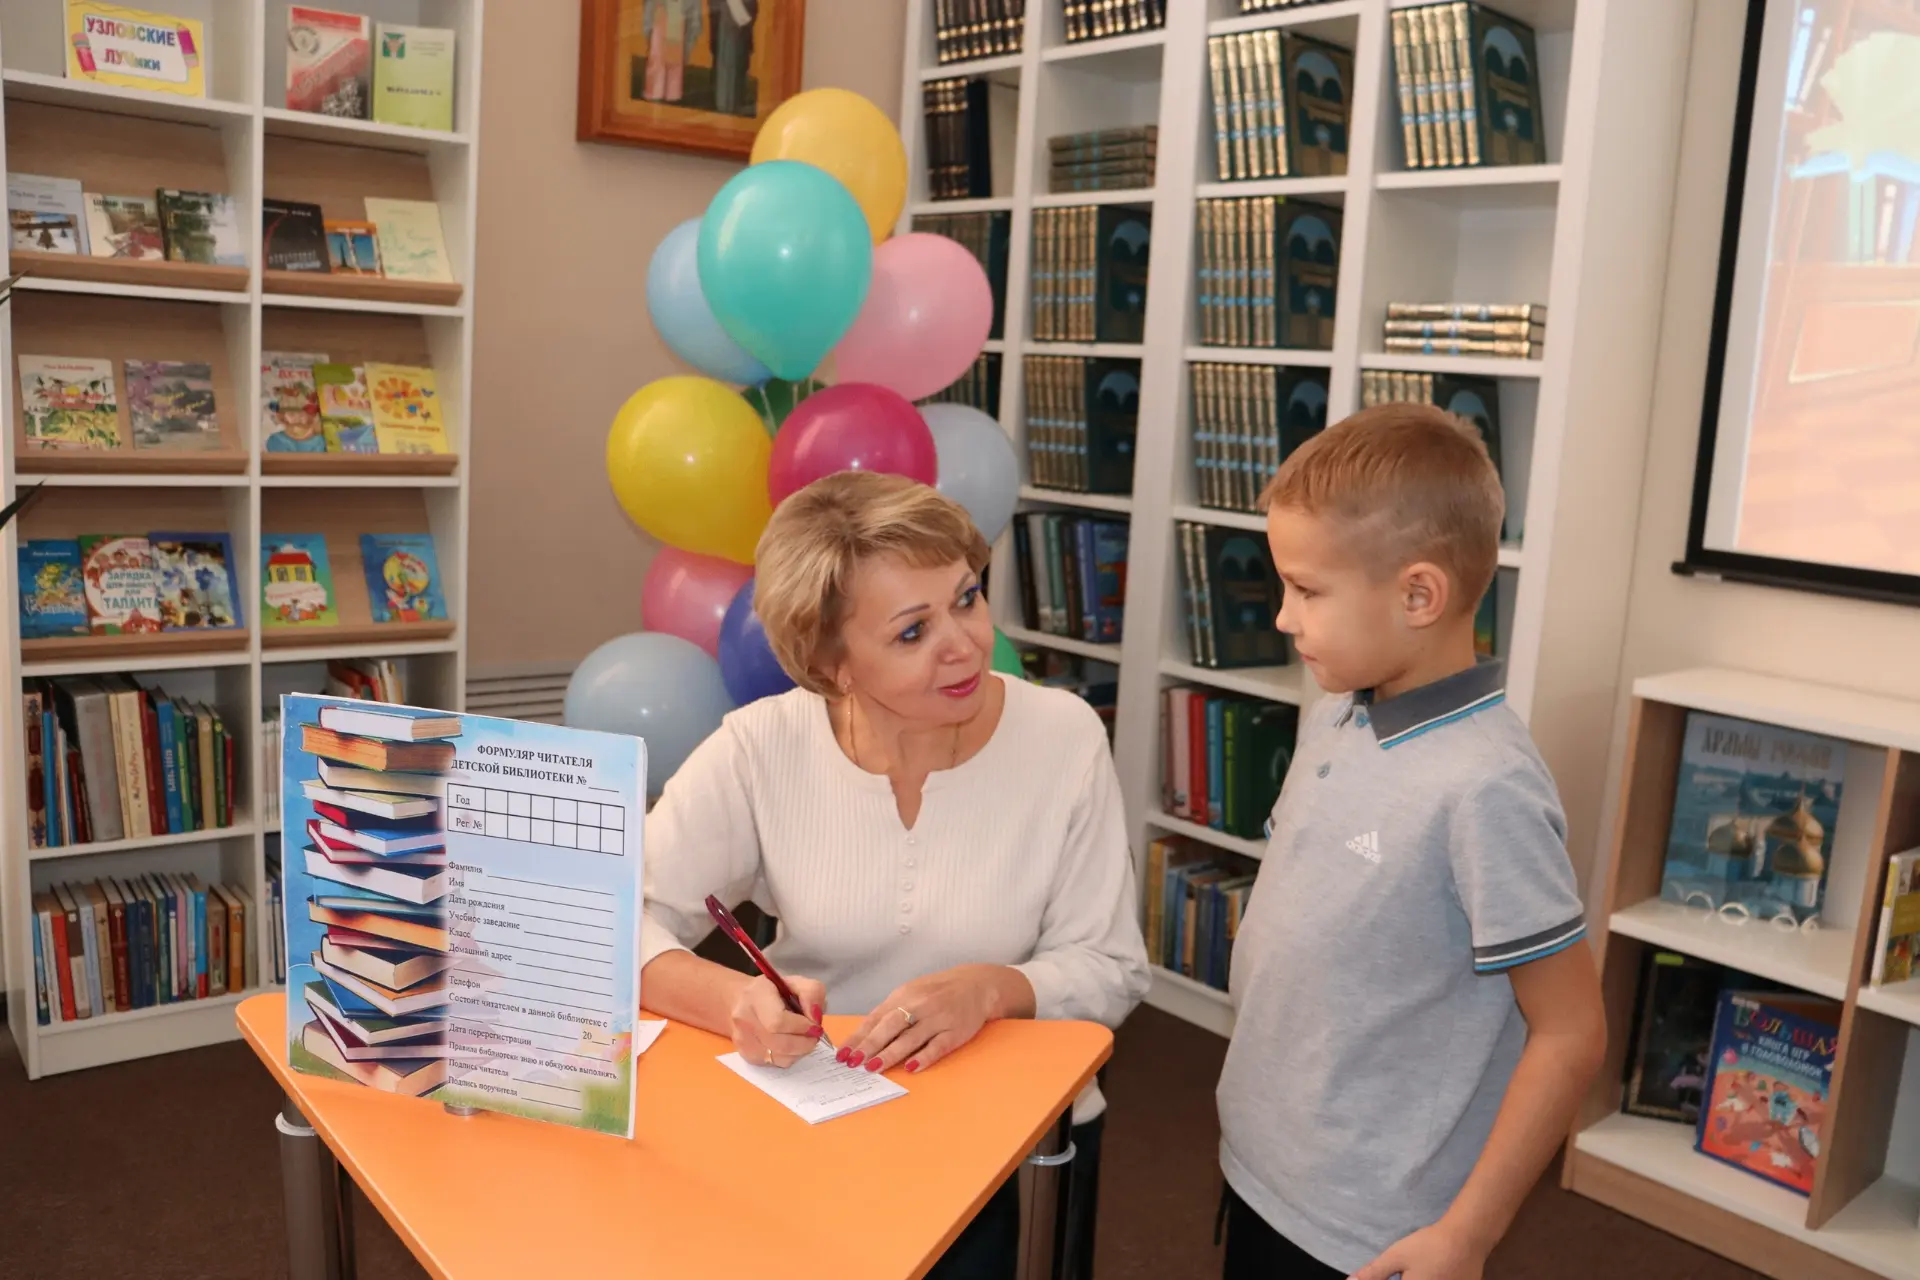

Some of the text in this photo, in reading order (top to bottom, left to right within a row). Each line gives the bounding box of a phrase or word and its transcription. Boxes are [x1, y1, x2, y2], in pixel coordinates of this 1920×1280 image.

[86, 16, 176, 47] УЗЛОВСКИЕ
[477, 744, 593, 769] ФОРМУЛЯР ЧИТАТЕЛЯ
[451, 759, 587, 785] ДЕТСКОЙ БИБЛИОТЕКИ №
[455, 794, 470, 806] Год
[472, 820, 482, 830] №
[449, 861, 483, 874] Фамилия
[449, 877, 465, 888] Имя
[449, 894, 505, 912] Дата рождения
[449, 911, 520, 930] Учебное заведение
[449, 927, 471, 938] Класс
[449, 943, 512, 962] Домашний адрес
[449, 976, 481, 989] Телефон
[449, 992, 480, 1006] Состоит
[482, 999, 520, 1013] читателем
[528, 1008, 556, 1020] данной
[557, 1012, 602, 1027] библиотеке
[449, 1024, 532, 1046] Дата перерегистрации
[582, 1031, 592, 1040] 20
[449, 1042, 478, 1054] Правила
[479, 1046, 518, 1061] библиотеки
[520, 1056, 537, 1065] знаю
[545, 1059, 578, 1072] обязуюсь
[449, 1059, 509, 1077] Подпись читателя
[448, 1076, 518, 1097] Подпись поручителя
